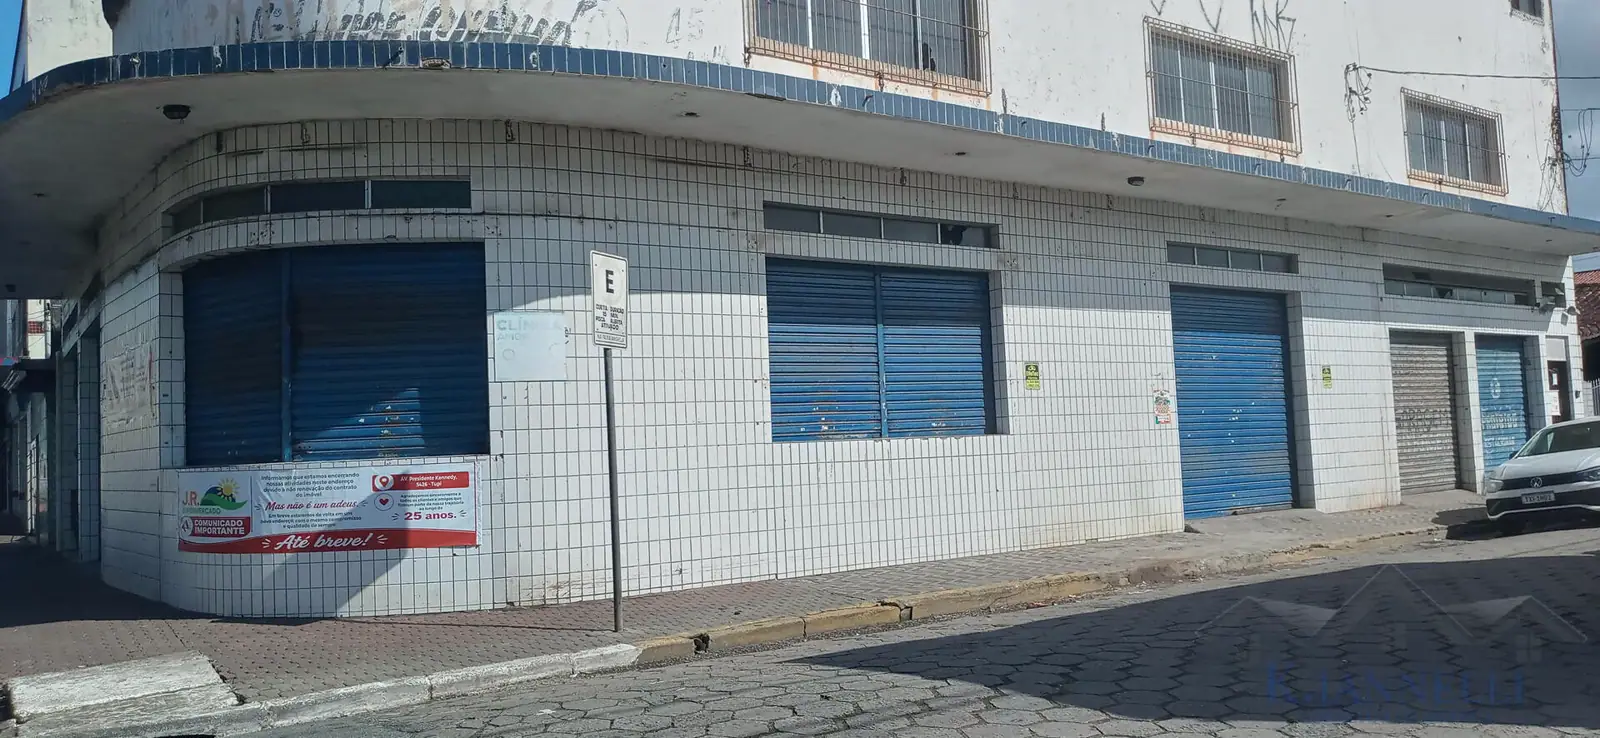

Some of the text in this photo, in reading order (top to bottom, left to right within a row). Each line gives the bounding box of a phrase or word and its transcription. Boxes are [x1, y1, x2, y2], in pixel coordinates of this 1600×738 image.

[605, 269, 614, 294] E
[265, 502, 285, 511] Mas
[306, 501, 312, 509] é
[404, 511, 457, 520] 25 anos.
[194, 526, 245, 535] IMPORTANTE
[274, 533, 374, 550] Até breve!
